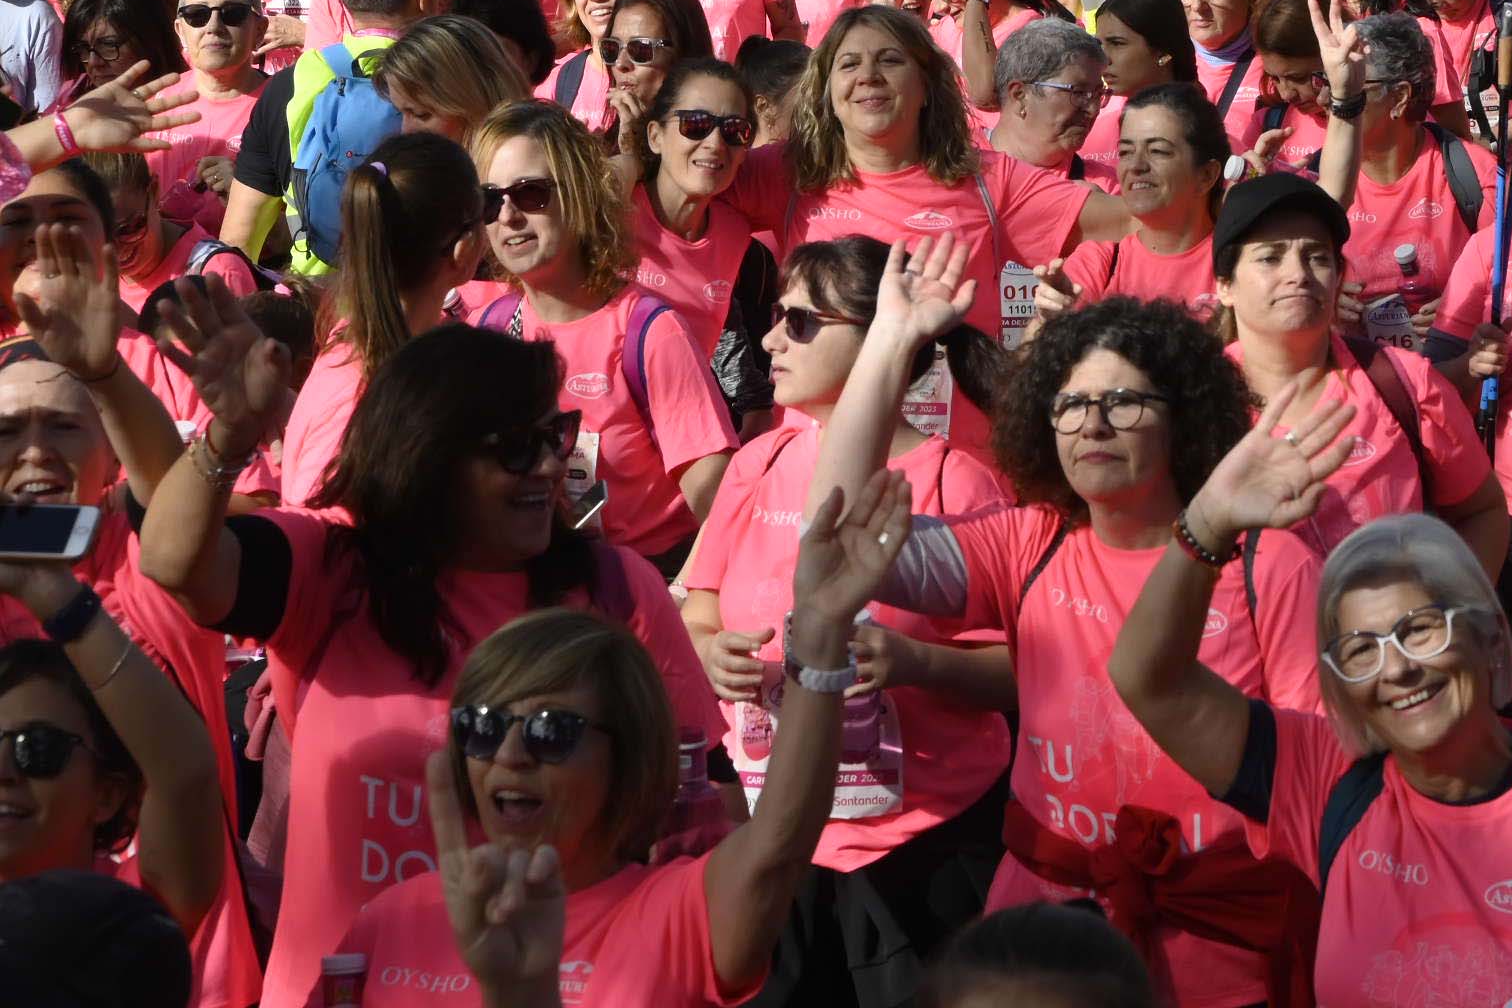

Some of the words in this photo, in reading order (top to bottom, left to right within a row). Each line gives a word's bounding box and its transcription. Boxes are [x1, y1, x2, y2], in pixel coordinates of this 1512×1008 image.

[808, 207, 862, 221] OYSHO
[1375, 334, 1413, 348] 16
[360, 774, 422, 827] TU
[834, 795, 889, 807] Santander
[380, 965, 472, 994] OYSHO
